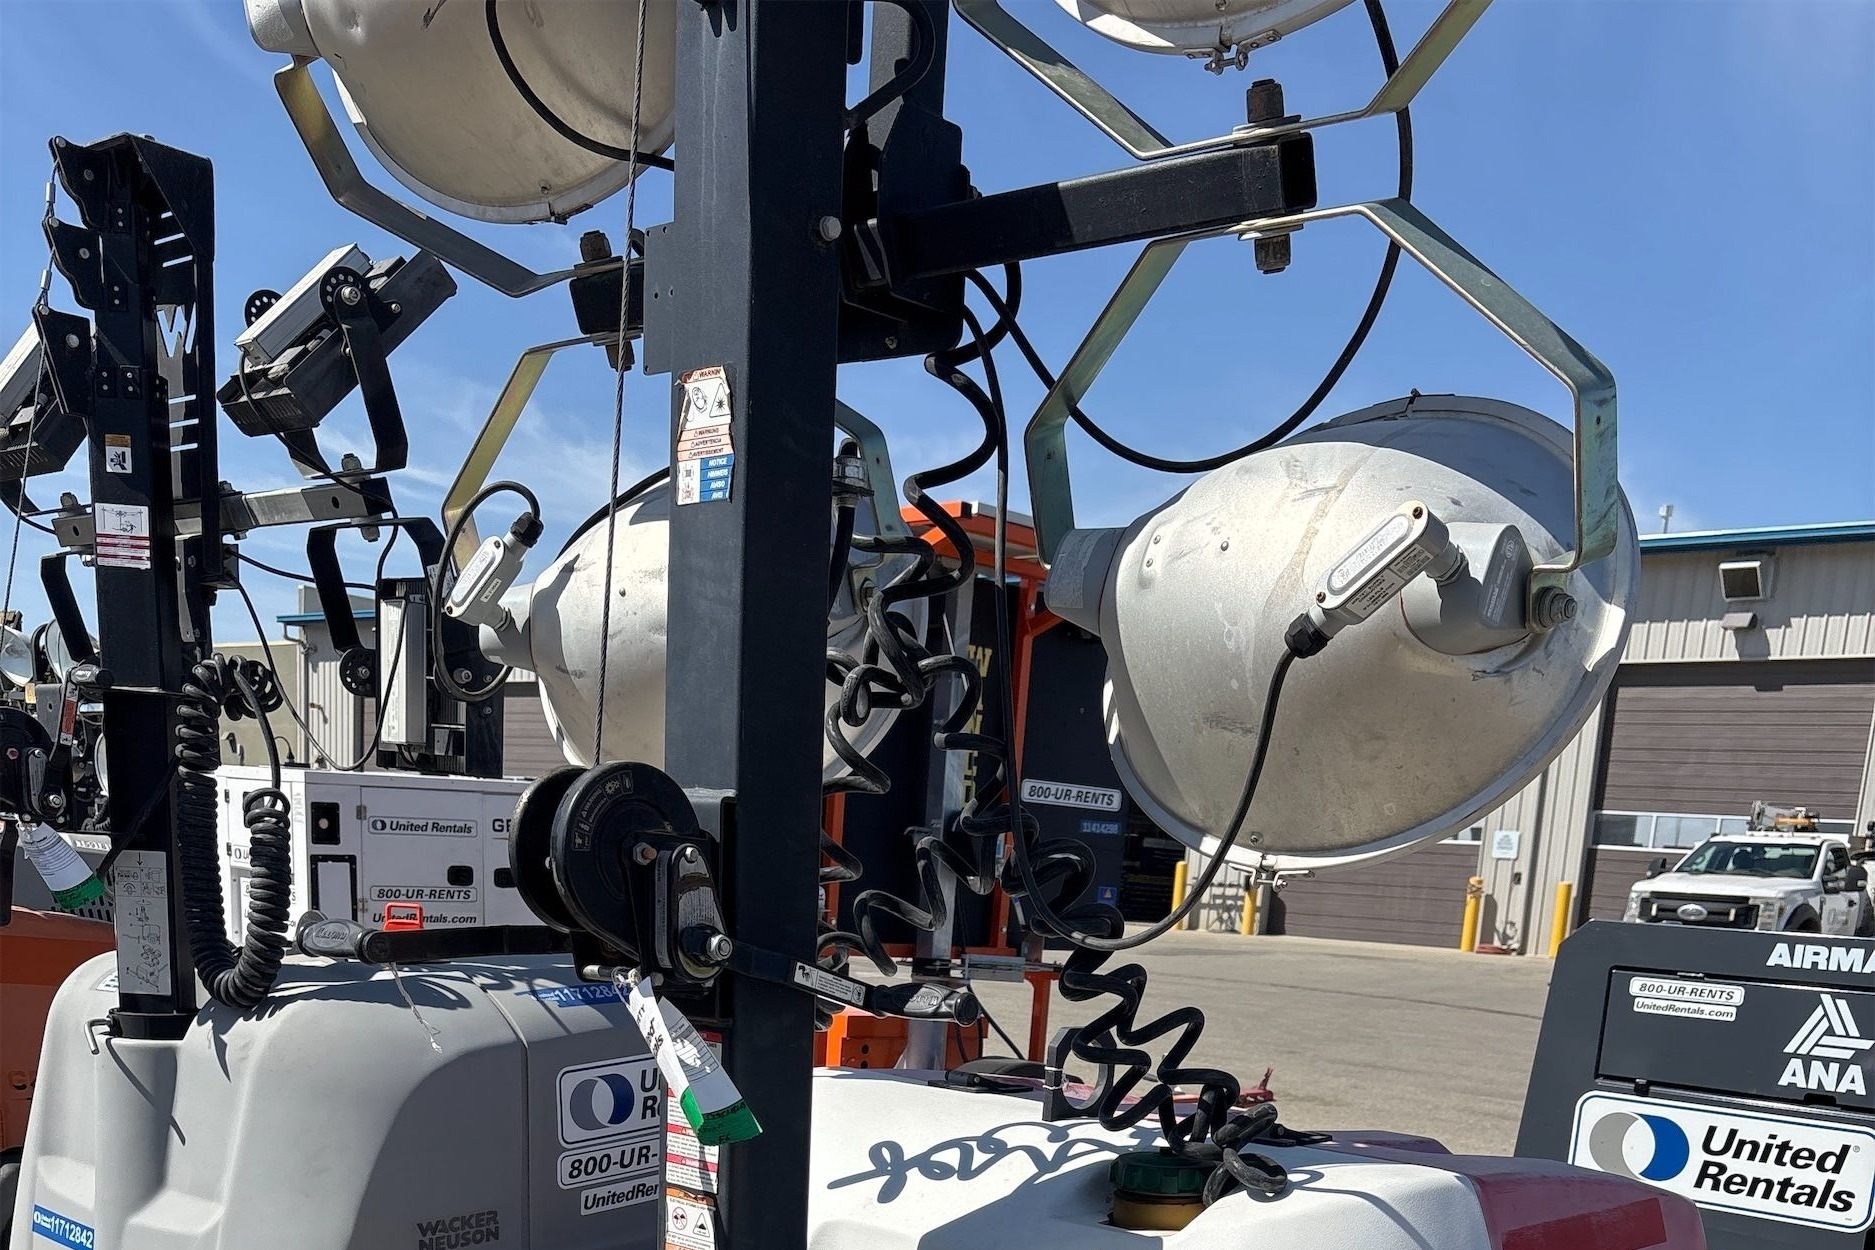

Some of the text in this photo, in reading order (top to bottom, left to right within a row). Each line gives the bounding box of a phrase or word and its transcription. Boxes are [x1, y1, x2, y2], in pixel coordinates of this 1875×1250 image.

[1028, 785, 1114, 806] 800-UR-RENTS
[390, 820, 473, 834] United Rentals
[377, 888, 471, 900] 800-UR-RENTS
[1639, 982, 1735, 1001] 800-UR-RENTS
[1636, 1001, 1734, 1019] UnitedRentals.com
[1777, 1057, 1867, 1096] ANA
[1701, 1125, 1852, 1175] United
[1693, 1159, 1856, 1213] Rentals
[50, 1215, 94, 1249] 11712842
[417, 1210, 500, 1237] WACKER
